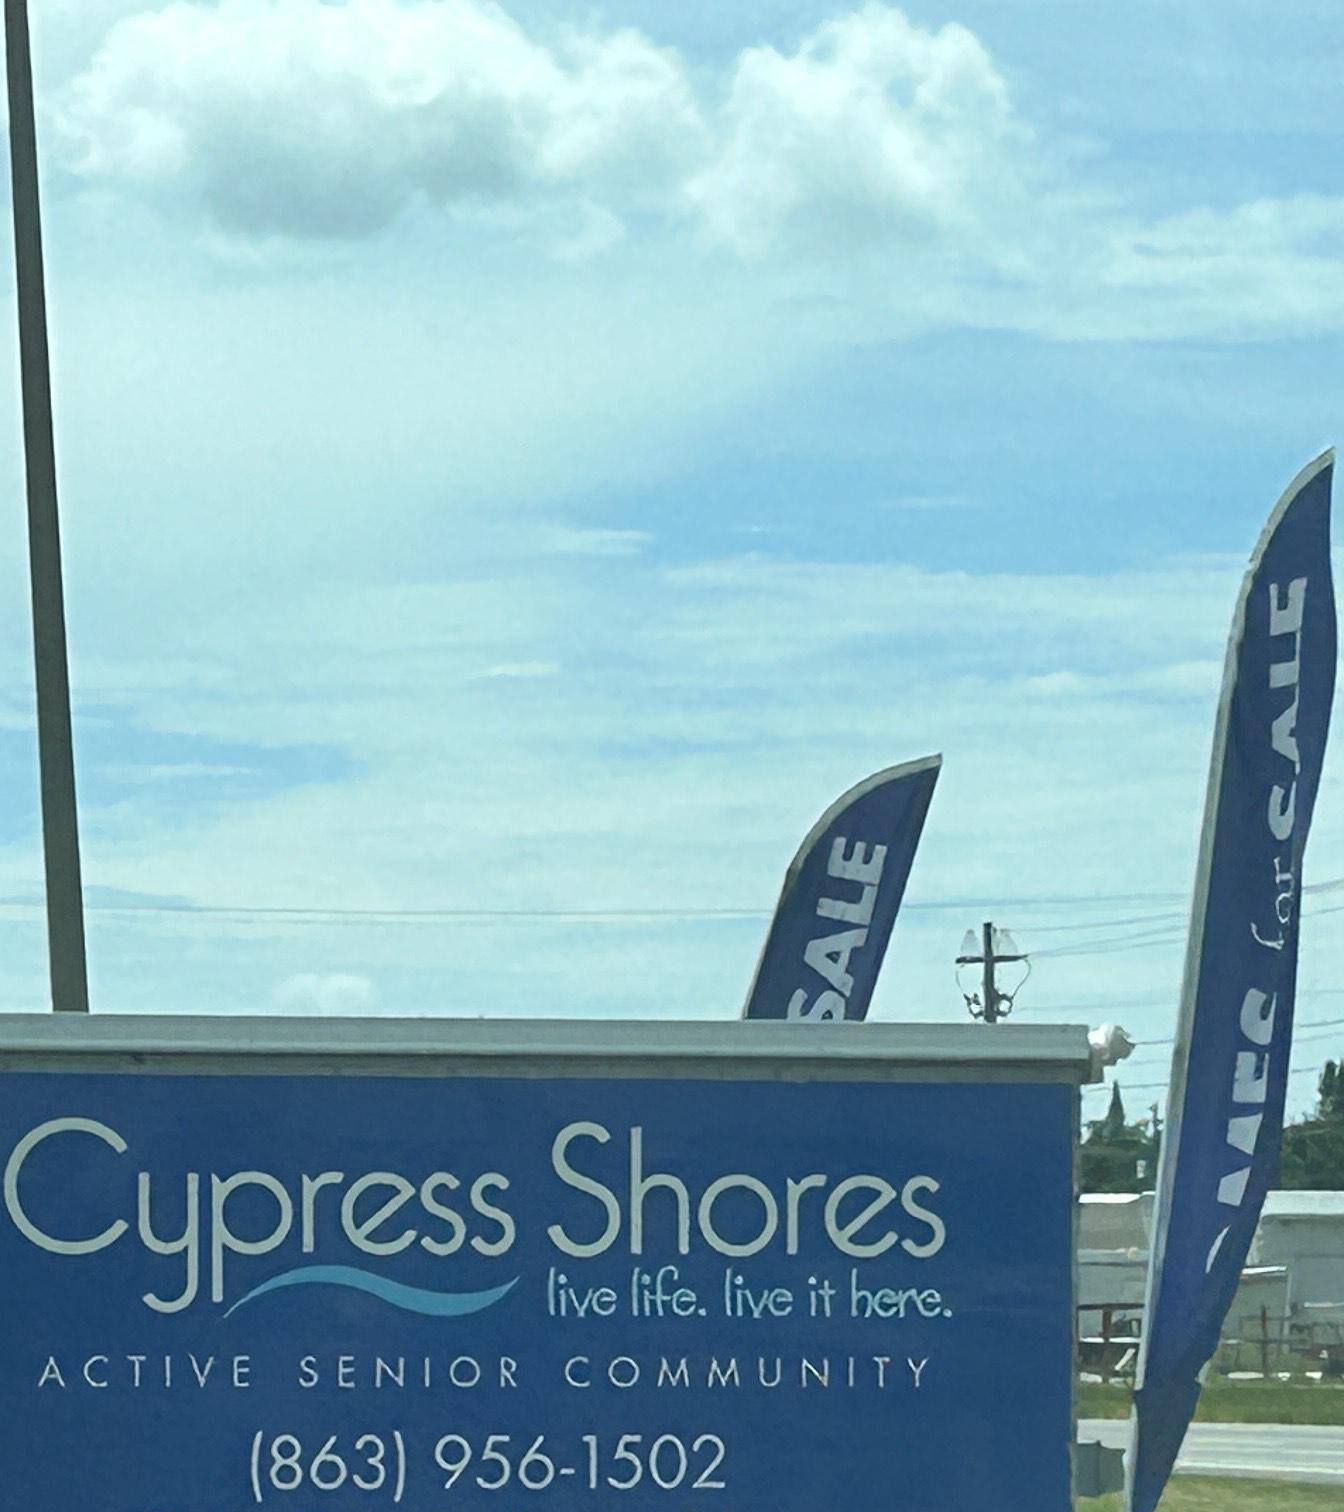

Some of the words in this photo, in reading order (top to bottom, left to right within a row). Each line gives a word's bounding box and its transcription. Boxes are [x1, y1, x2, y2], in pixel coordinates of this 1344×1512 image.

[786, 836, 888, 1021] SALE
[2, 1117, 517, 1316] Cypress
[547, 1121, 947, 1258] Shores
[547, 1267, 618, 1318] live
[631, 1265, 707, 1317] life.
[724, 1266, 794, 1318] live
[808, 1275, 837, 1318] it
[851, 1268, 953, 1318] here.
[38, 1355, 252, 1388] ACTIVE
[298, 1355, 519, 1388] SENIOR
[564, 1355, 930, 1388] COMMUNITY
[251, 1430, 406, 1503] (863)
[435, 1433, 726, 1490] 956-1502
